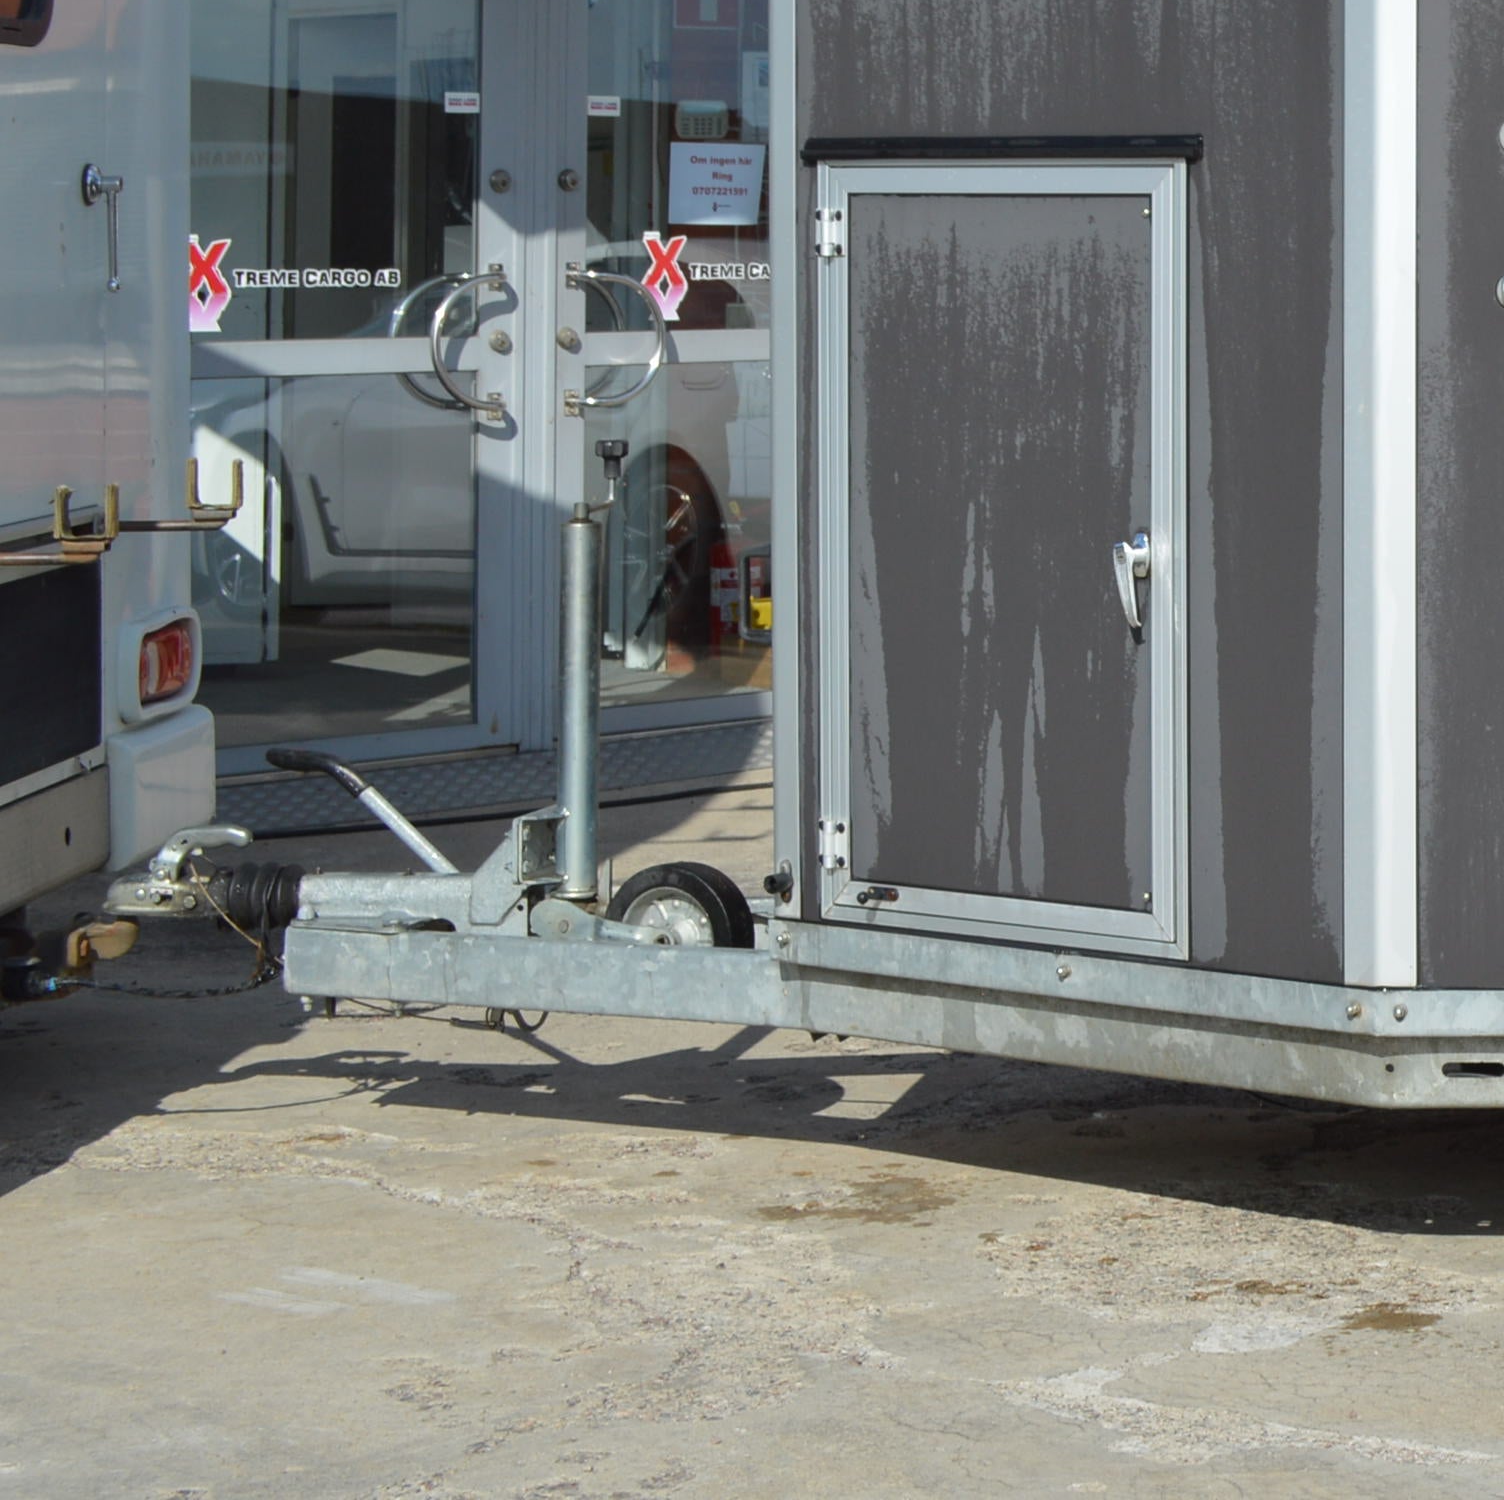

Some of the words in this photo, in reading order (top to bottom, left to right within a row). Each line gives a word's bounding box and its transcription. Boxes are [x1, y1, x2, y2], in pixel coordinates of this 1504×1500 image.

[690, 155, 707, 165] Om
[709, 156, 736, 167] ingen
[712, 171, 733, 182] Ring
[304, 269, 371, 288] CARGO
[374, 269, 401, 287] AB
